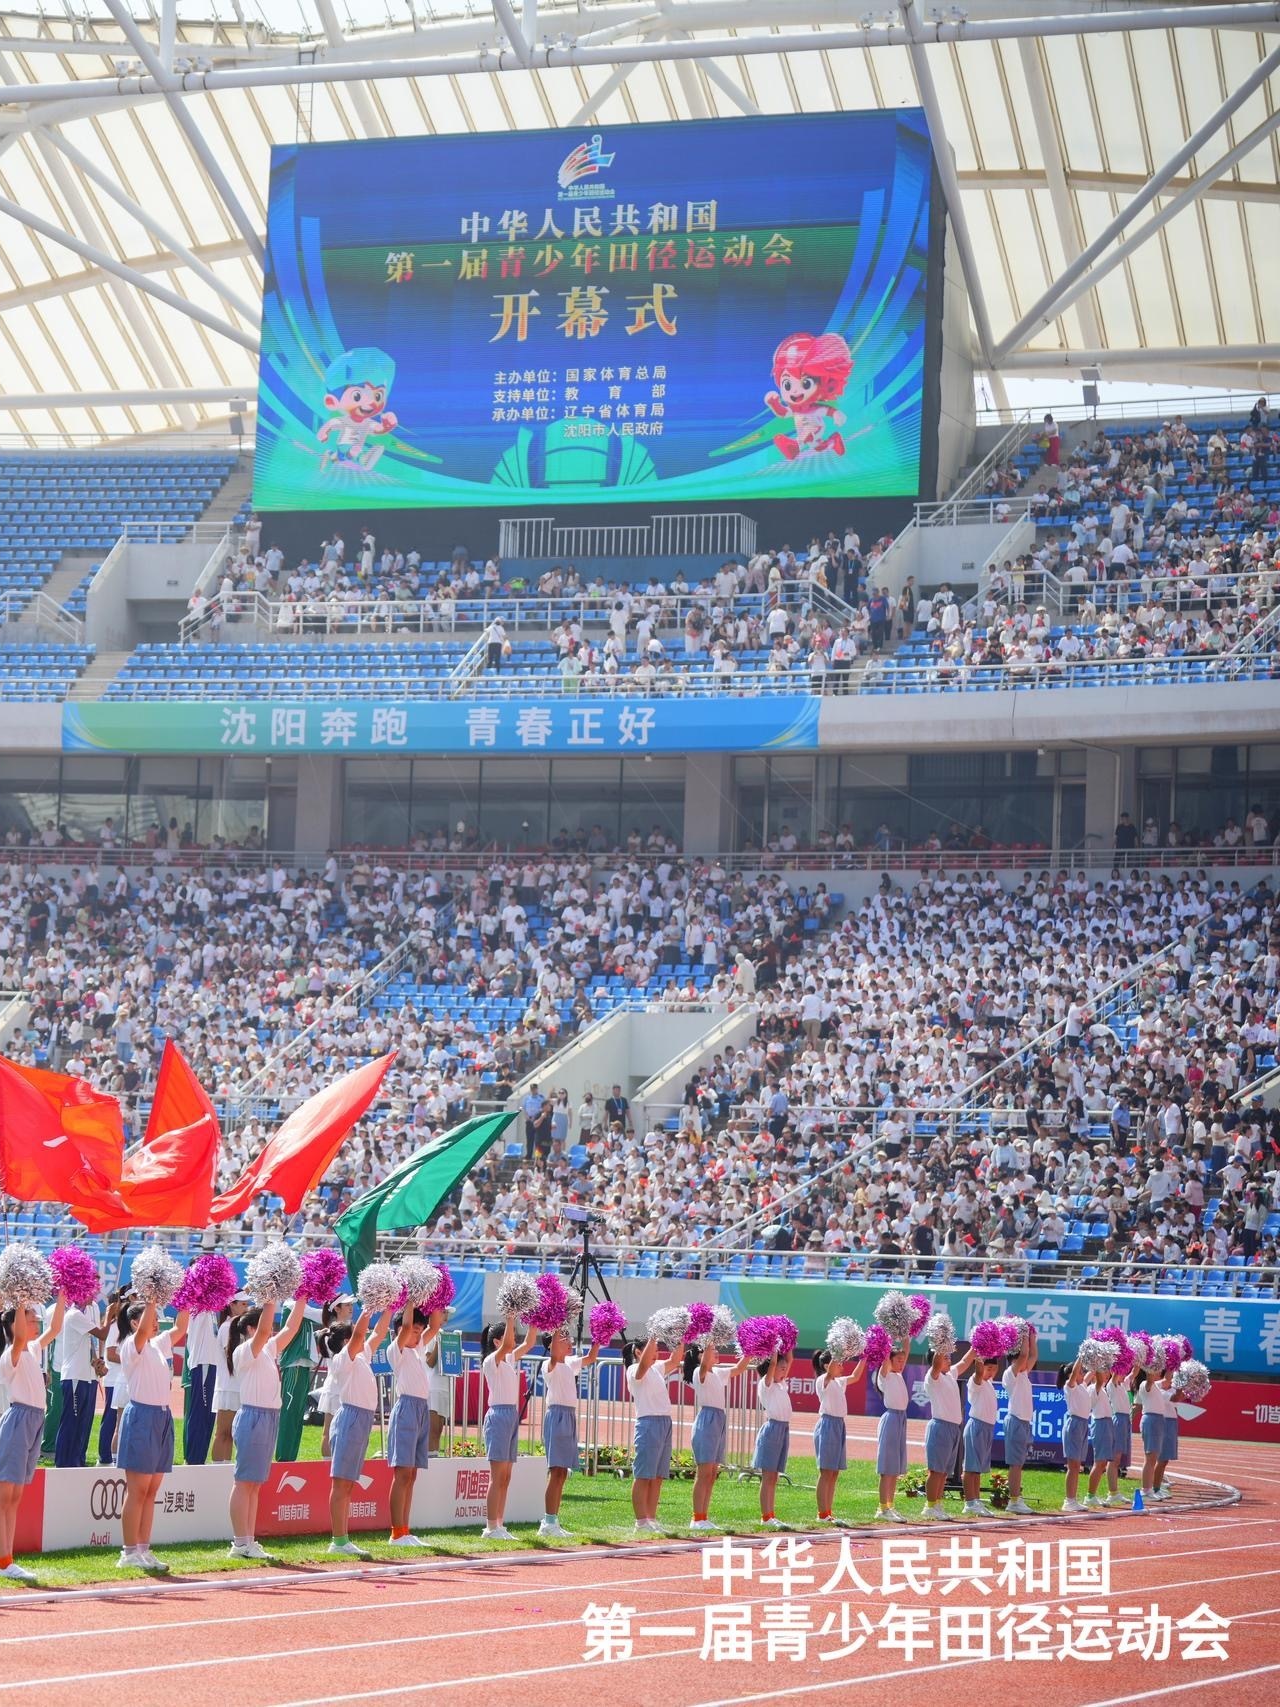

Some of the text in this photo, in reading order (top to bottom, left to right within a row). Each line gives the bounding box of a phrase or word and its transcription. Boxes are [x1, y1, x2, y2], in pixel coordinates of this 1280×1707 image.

[460, 199, 718, 244] 中华人民共和国
[384, 233, 795, 284] 第一届青少年田径运动会
[489, 282, 679, 343] 开幕式
[564, 422, 664, 438] 沈阳市人民政府
[220, 706, 656, 745] 沈阳奔跑 青春正好
[154, 1491, 195, 1513] 一汽奥迪
[271, 1502, 311, 1521] 一切皆有可能
[90, 1531, 111, 1546] Audi
